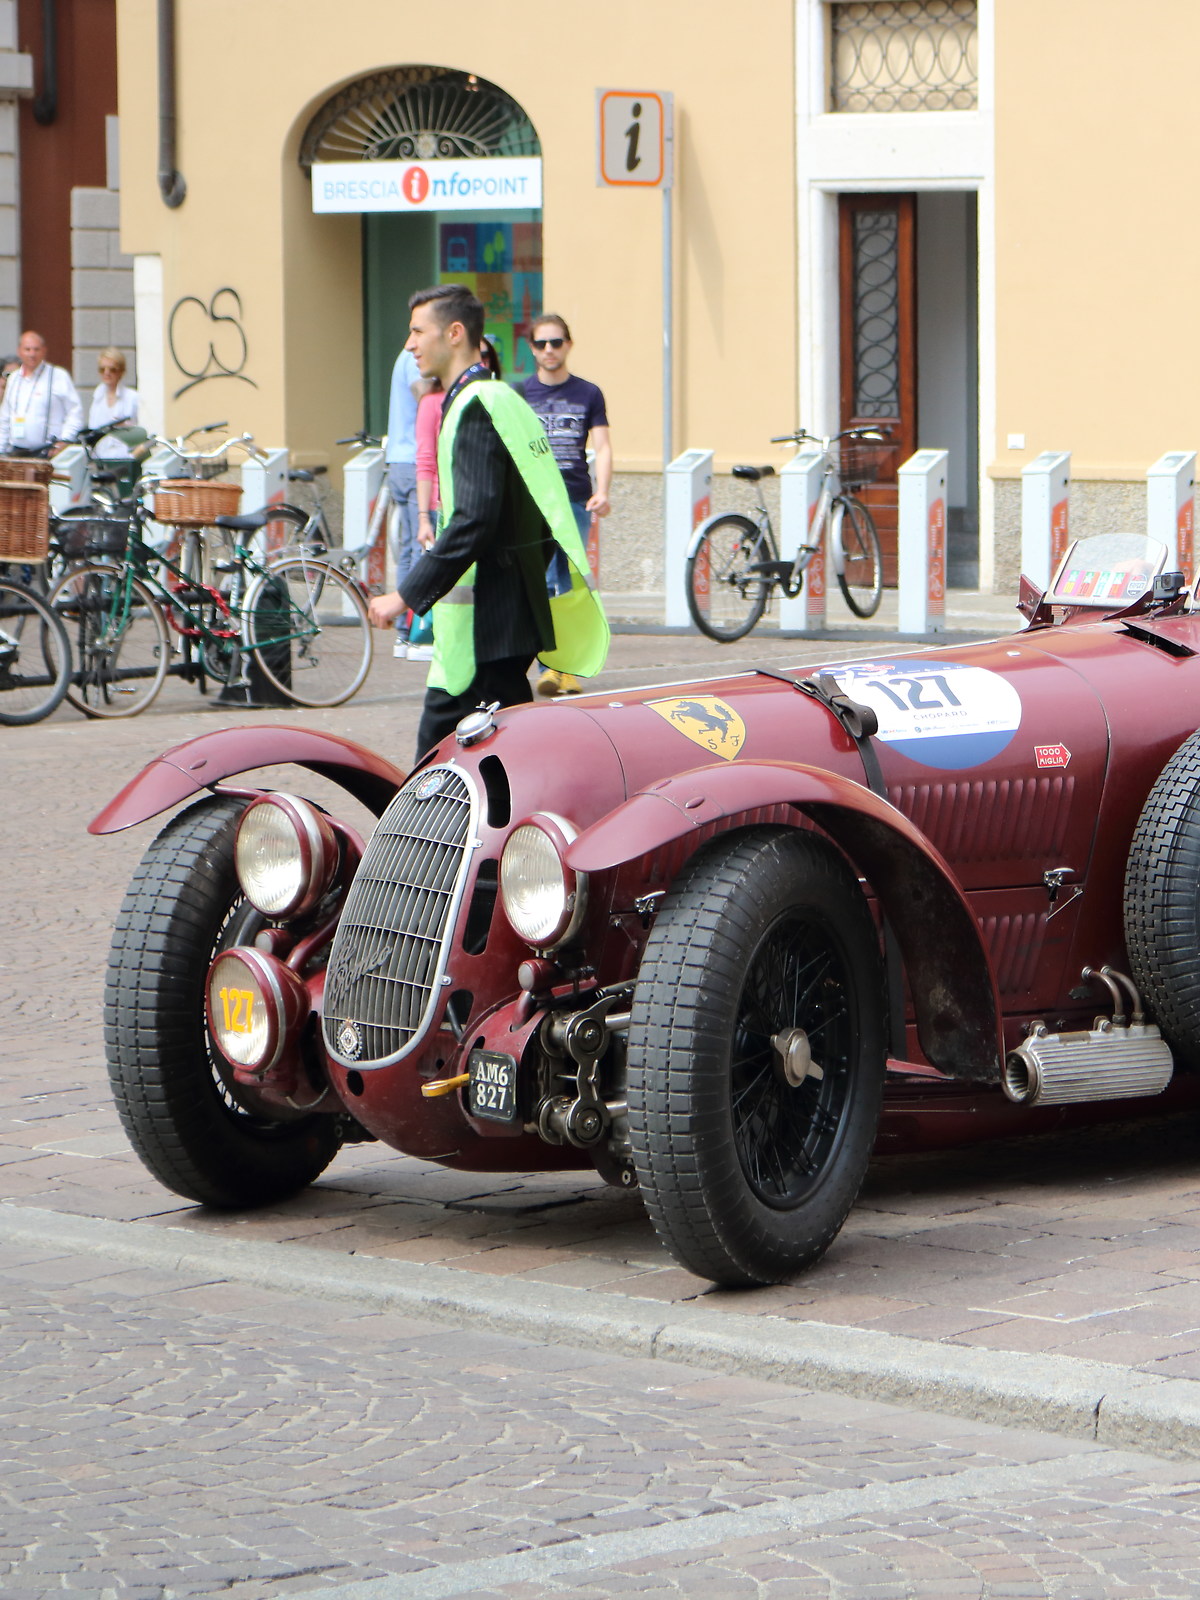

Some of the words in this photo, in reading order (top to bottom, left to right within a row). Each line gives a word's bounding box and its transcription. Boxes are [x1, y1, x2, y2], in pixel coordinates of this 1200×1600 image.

[323, 180, 399, 200] BRESCIA
[865, 675, 962, 711] 127
[913, 710, 968, 721] CHOPARD
[1039, 747, 1061, 757] 1000
[1039, 756, 1065, 766] MIGLIA
[219, 987, 254, 1033] 127
[475, 1061, 509, 1087] AM6
[475, 1082, 507, 1110] 827
